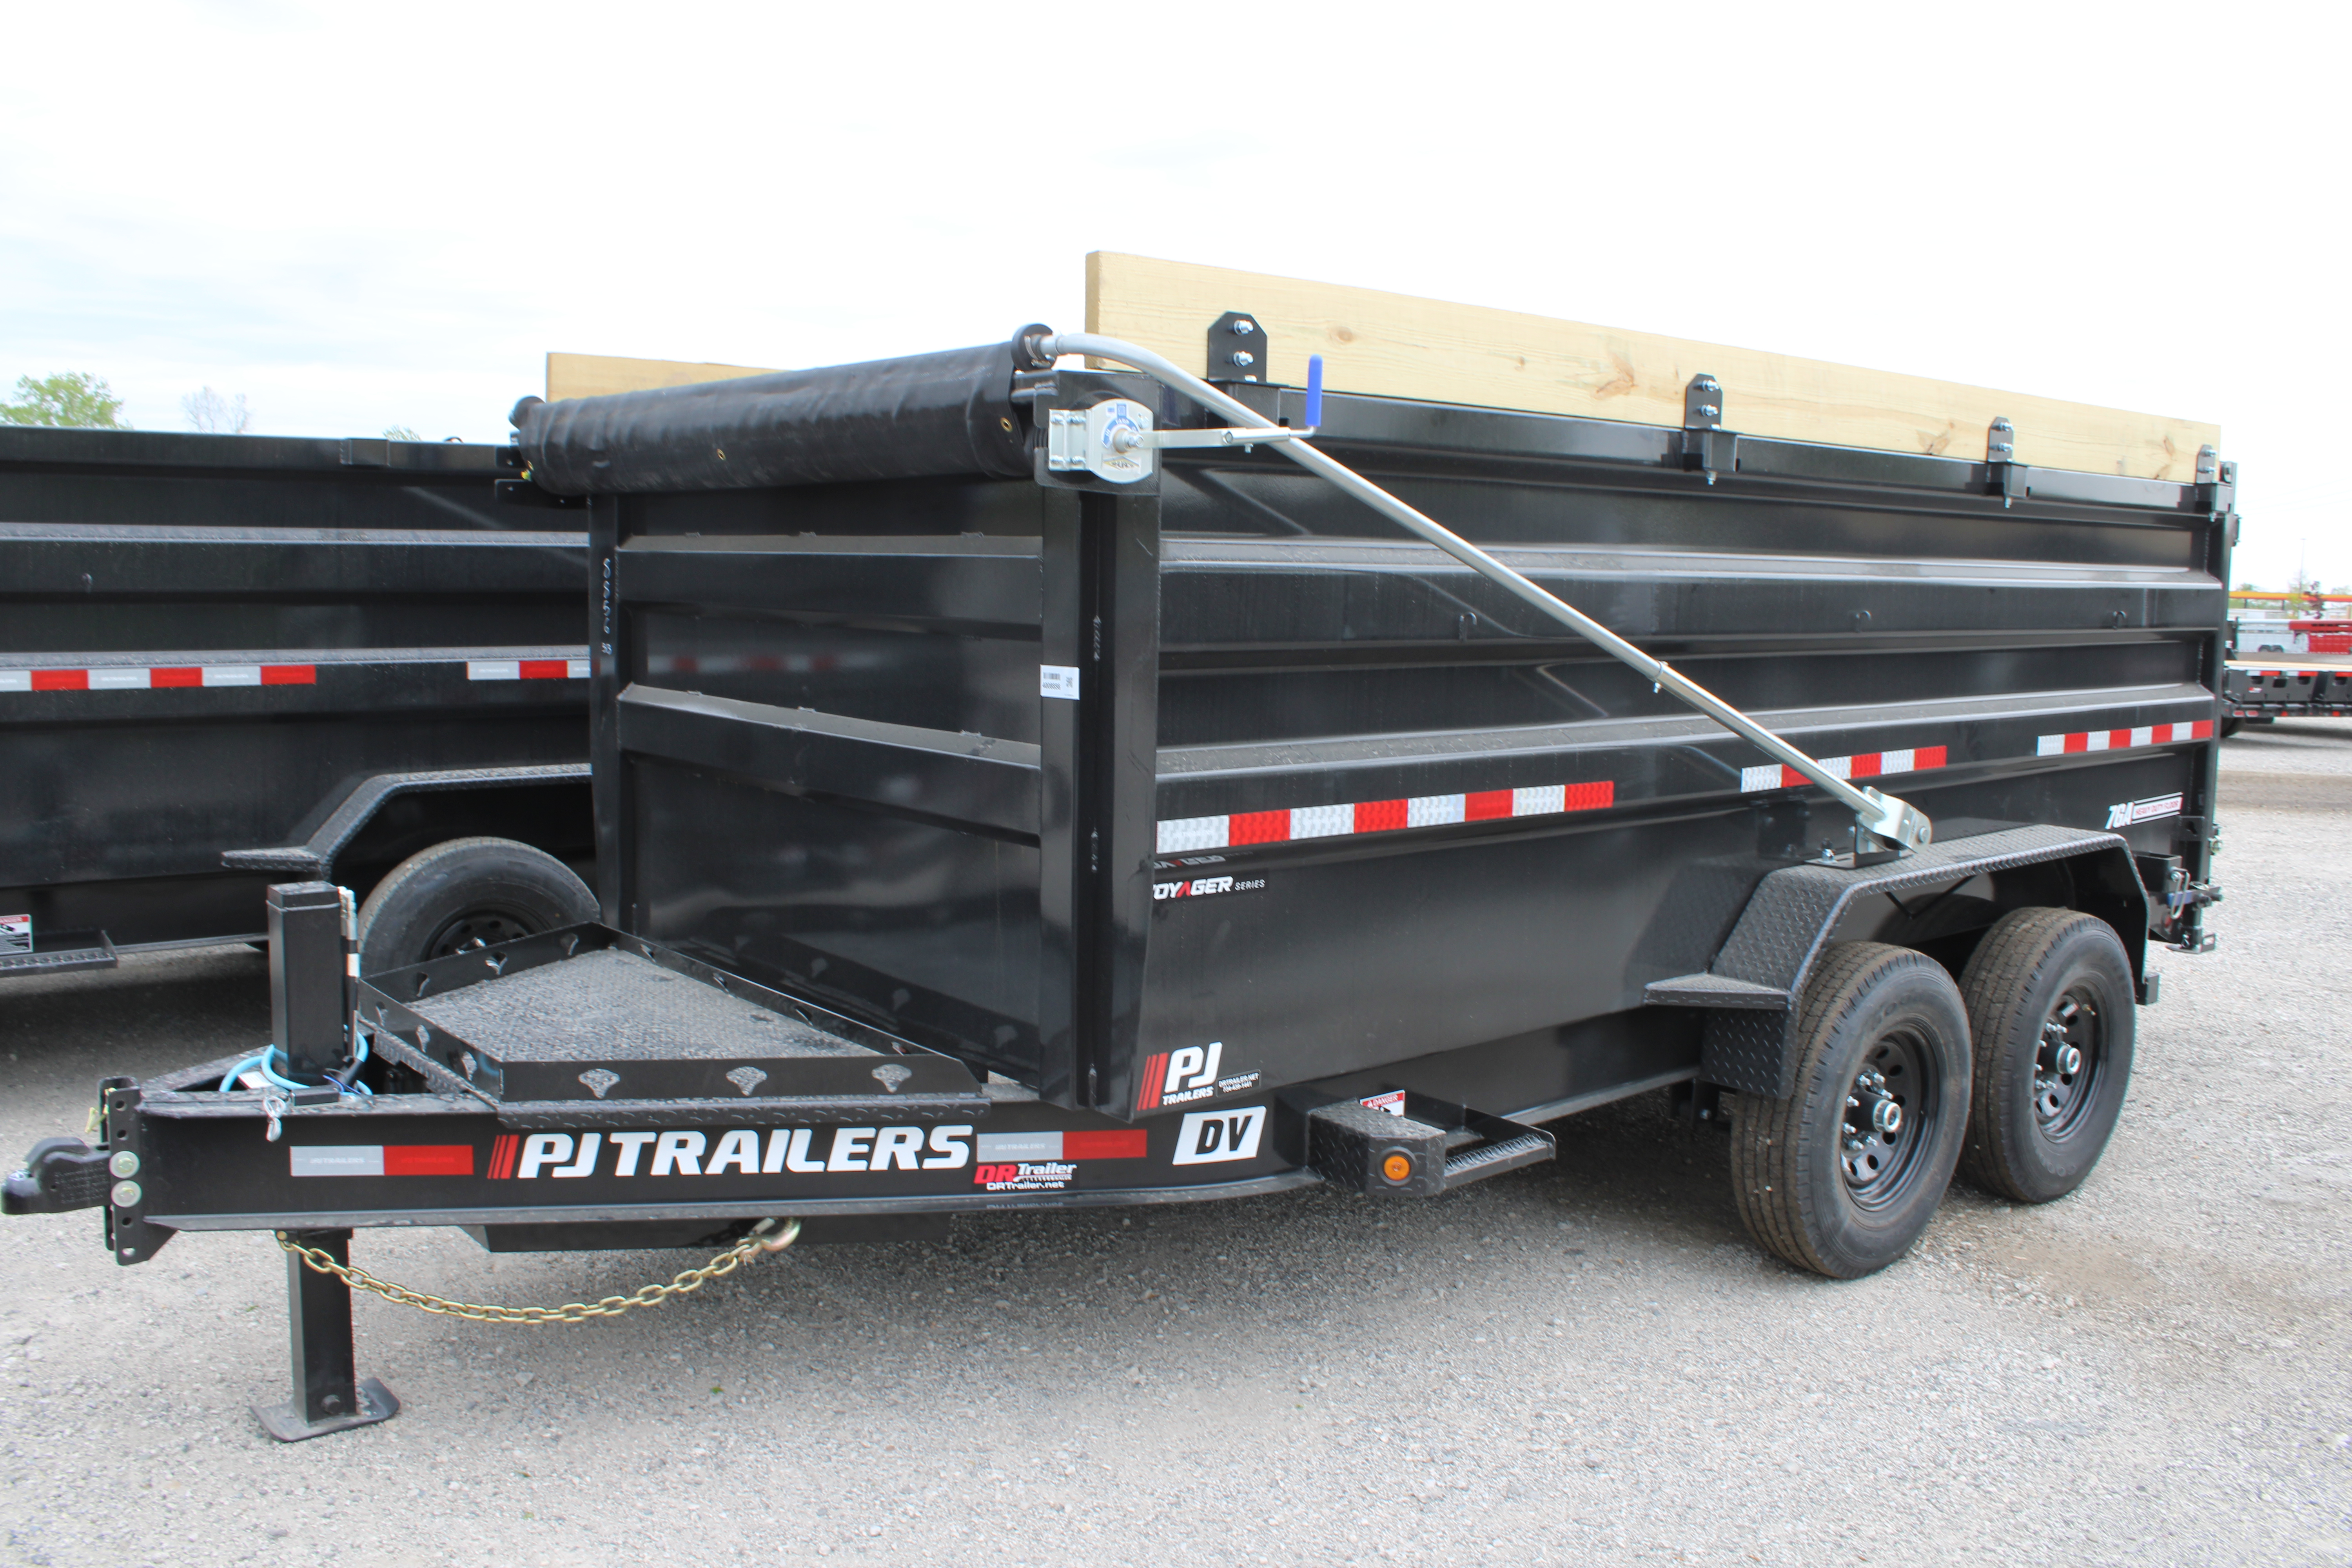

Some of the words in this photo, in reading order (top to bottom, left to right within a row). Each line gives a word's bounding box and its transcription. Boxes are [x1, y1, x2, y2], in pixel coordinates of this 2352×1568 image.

[2104, 801, 2135, 830] 7GA
[1153, 876, 1234, 900] OYAGER
[1235, 879, 1265, 891] SERIES
[1164, 1041, 1223, 1094] PJ
[1162, 1085, 1214, 1106] TRAILERS
[1373, 1094, 1398, 1106] DANGER
[1194, 1114, 1254, 1155] DV
[517, 1132, 601, 1179] PJ
[609, 1125, 974, 1176] TRAILERS
[986, 1179, 1065, 1191] DRTrailer.net
